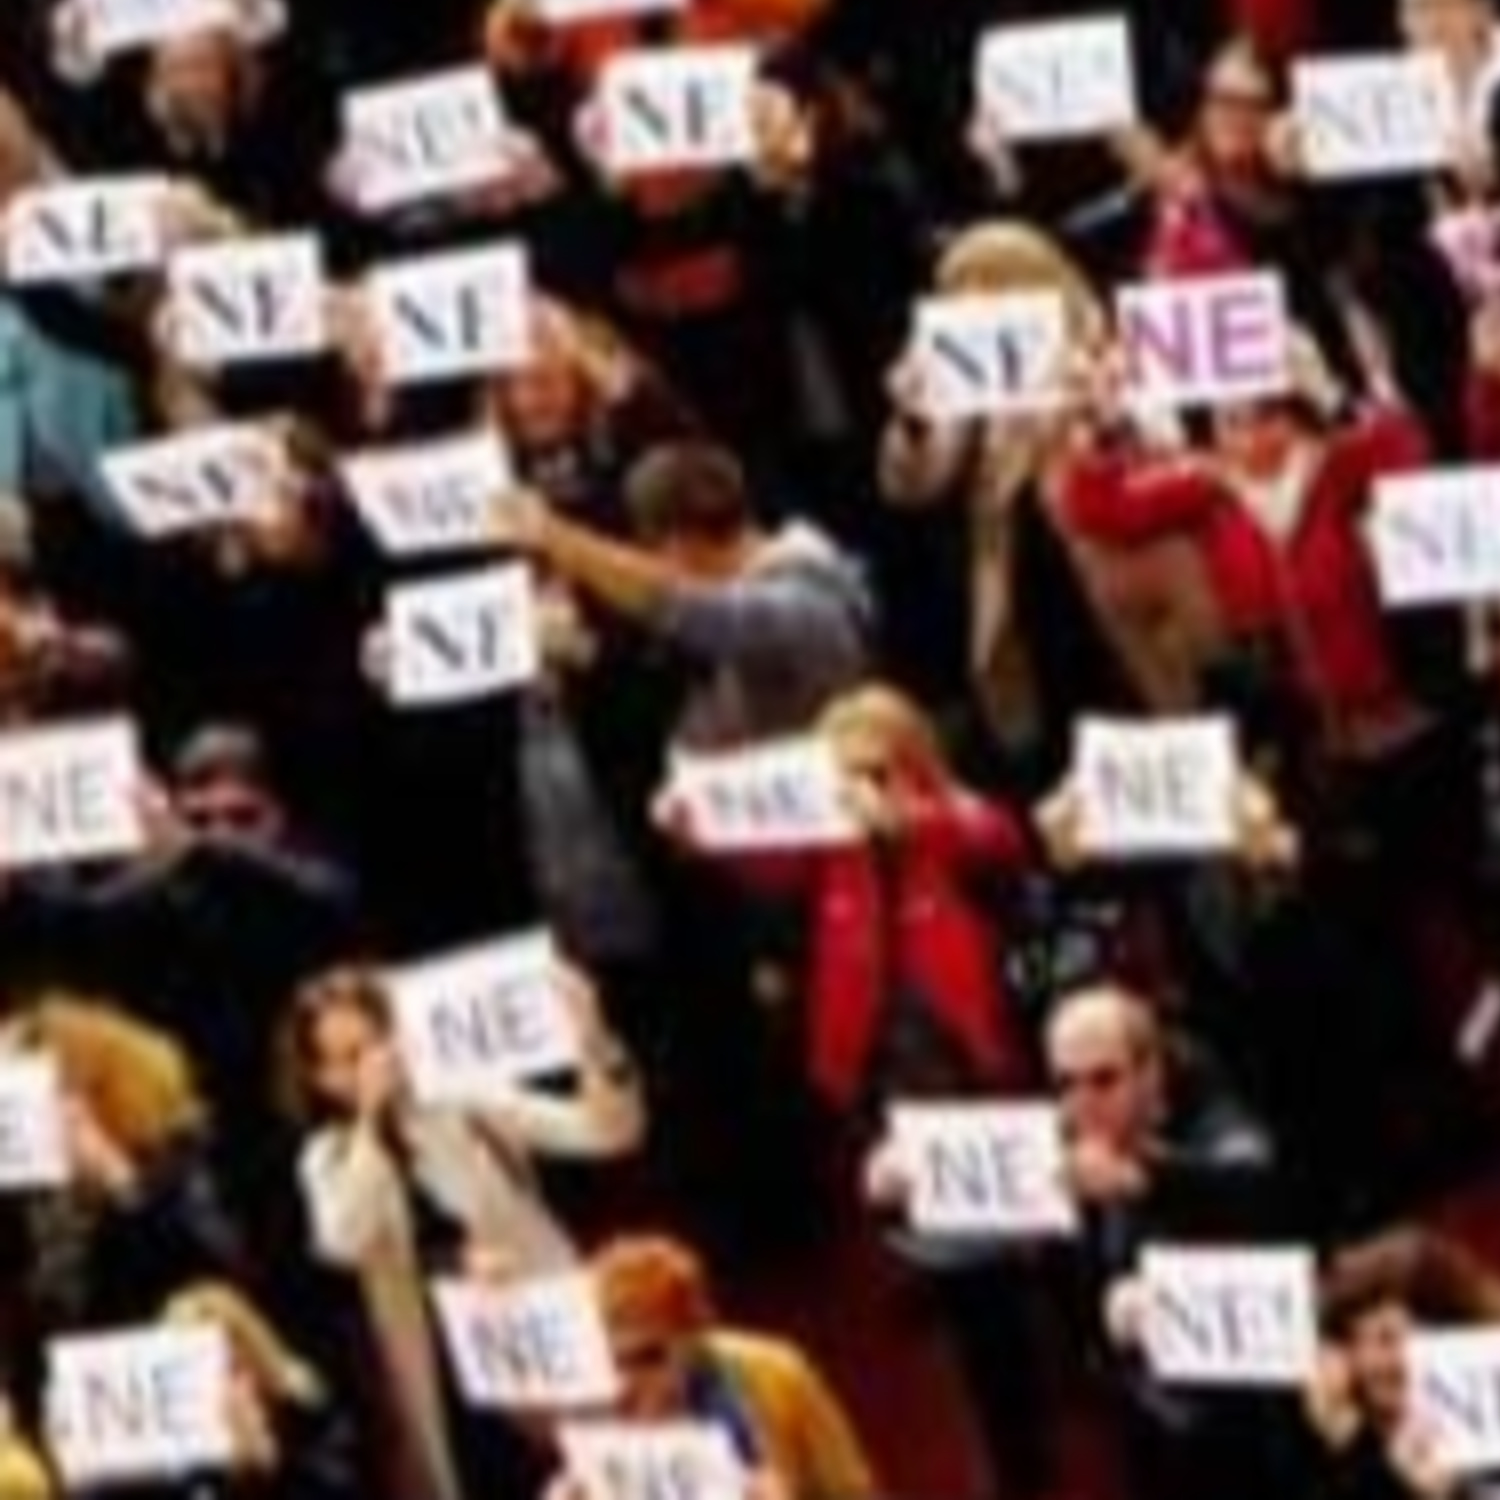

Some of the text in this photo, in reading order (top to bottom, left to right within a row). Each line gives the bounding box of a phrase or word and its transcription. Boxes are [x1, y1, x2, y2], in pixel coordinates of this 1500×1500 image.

[1117, 292, 1278, 388] NE
[0, 763, 108, 832] NE
[1100, 753, 1208, 817] NE
[432, 984, 548, 1058] NE
[927, 1135, 1032, 1203] NE
[470, 1312, 568, 1382] NE
[85, 1362, 192, 1438] NE
